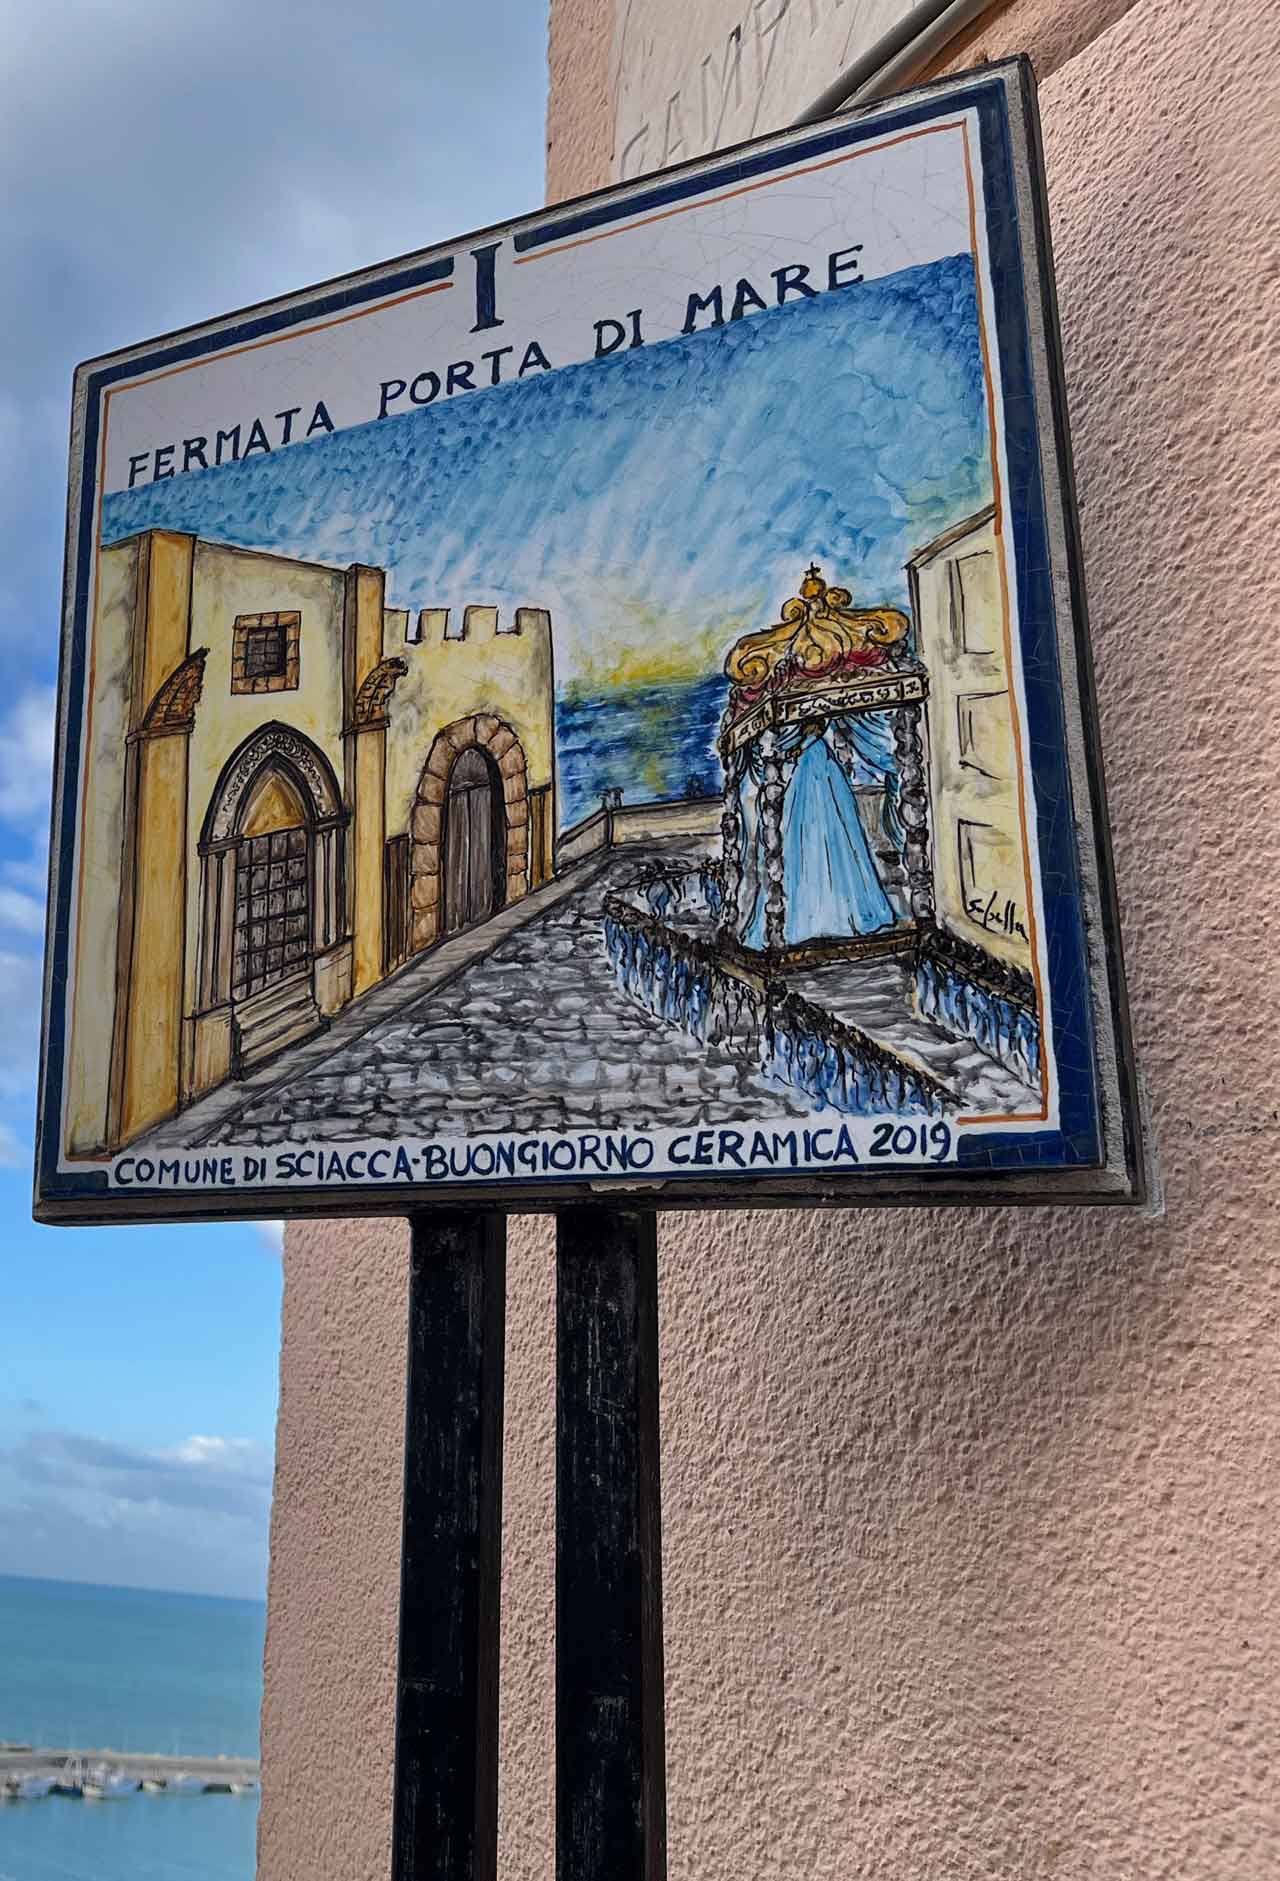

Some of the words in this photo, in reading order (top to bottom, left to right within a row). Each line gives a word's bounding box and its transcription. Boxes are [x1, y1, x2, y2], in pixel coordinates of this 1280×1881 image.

[470, 241, 505, 333] I
[128, 400, 335, 488] FERMATA
[377, 341, 552, 420] PORTA
[593, 308, 644, 360] DI
[682, 244, 865, 335] MARE
[114, 1156, 237, 1185] COMUNE
[244, 1156, 266, 1180] DI
[667, 1123, 858, 1167] CERAMICA
[869, 1121, 951, 1160] 2019
